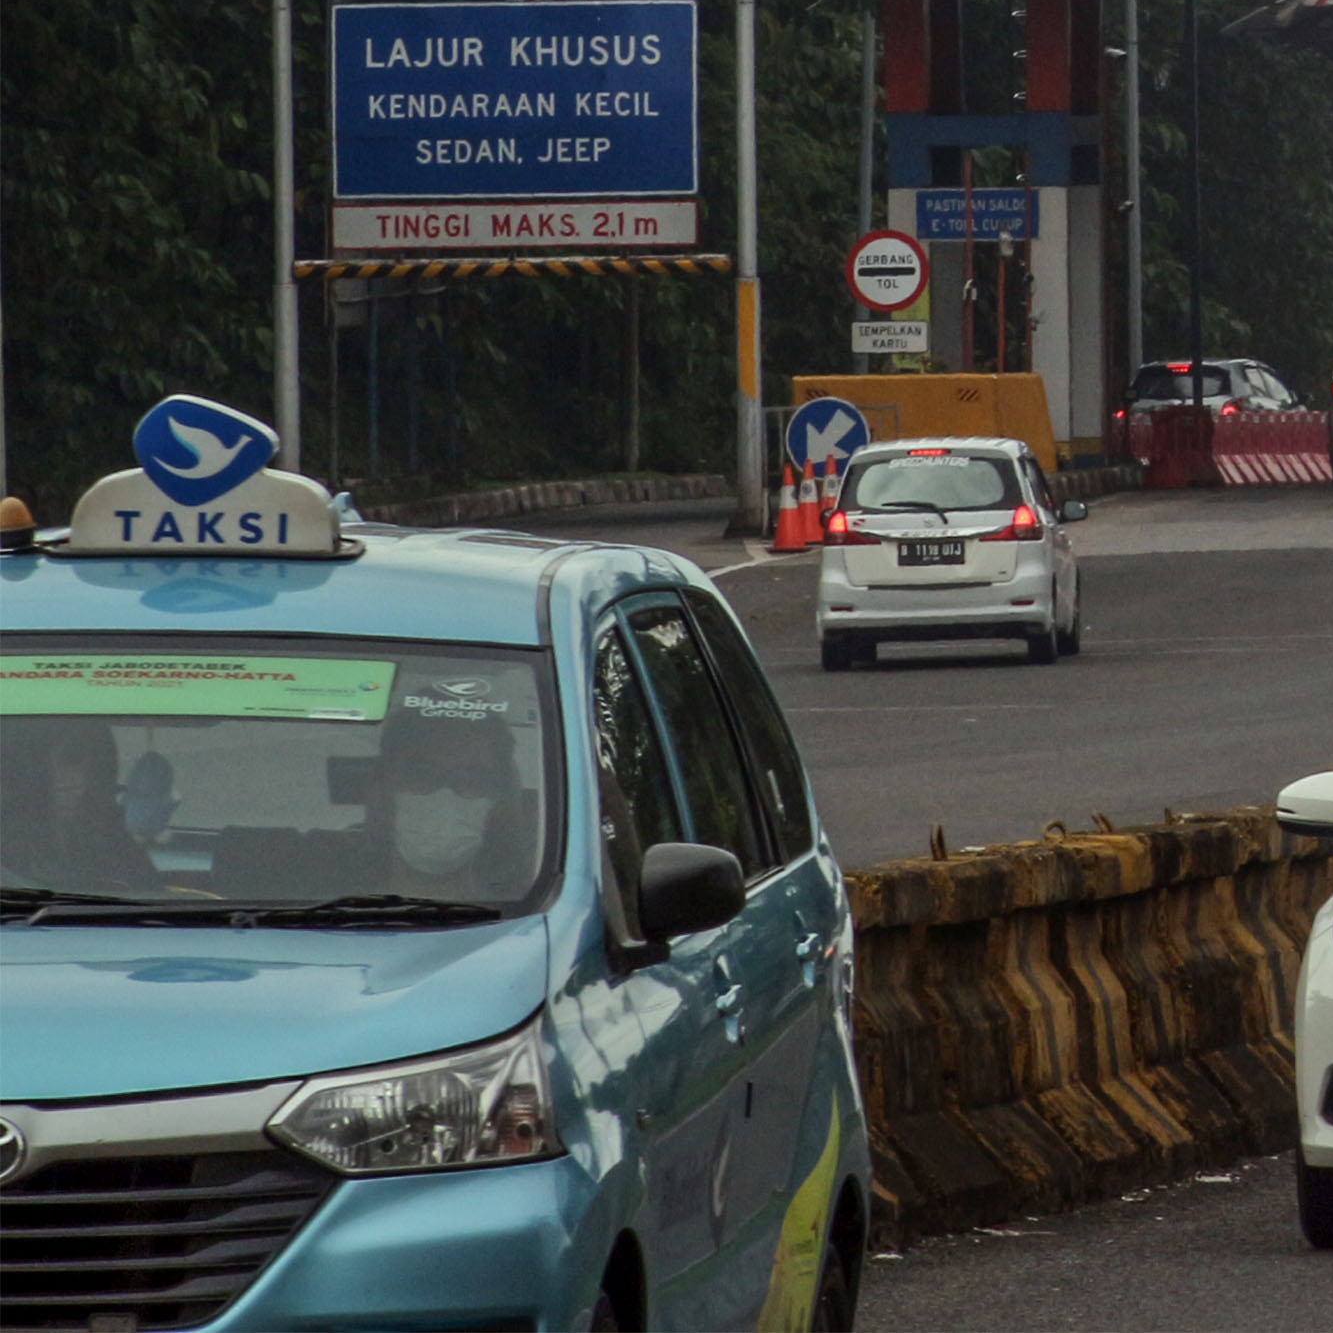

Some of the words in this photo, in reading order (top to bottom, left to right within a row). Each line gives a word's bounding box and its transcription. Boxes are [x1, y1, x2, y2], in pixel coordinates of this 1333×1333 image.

[365, 37, 485, 68] LAJUR
[511, 34, 662, 67] KHUSUS
[369, 93, 555, 119] KENDARAAN
[576, 91, 660, 116] KECIL
[416, 138, 523, 165] SEDAN,
[537, 137, 611, 163] JEEP
[376, 214, 470, 239] TINGGI
[492, 213, 580, 238] MAKS.
[858, 254, 914, 266] GERBANG
[876, 279, 899, 289] TOL
[858, 325, 922, 337] TEMPELKAN
[872, 338, 908, 349] KARTU
[114, 511, 289, 545] TAKSI
[99, 662, 247, 671] JABODETABEK
[92, 670, 296, 682] SOEKARNO-HATTA
[404, 695, 509, 713] Bluebird
[420, 706, 487, 721] Group
